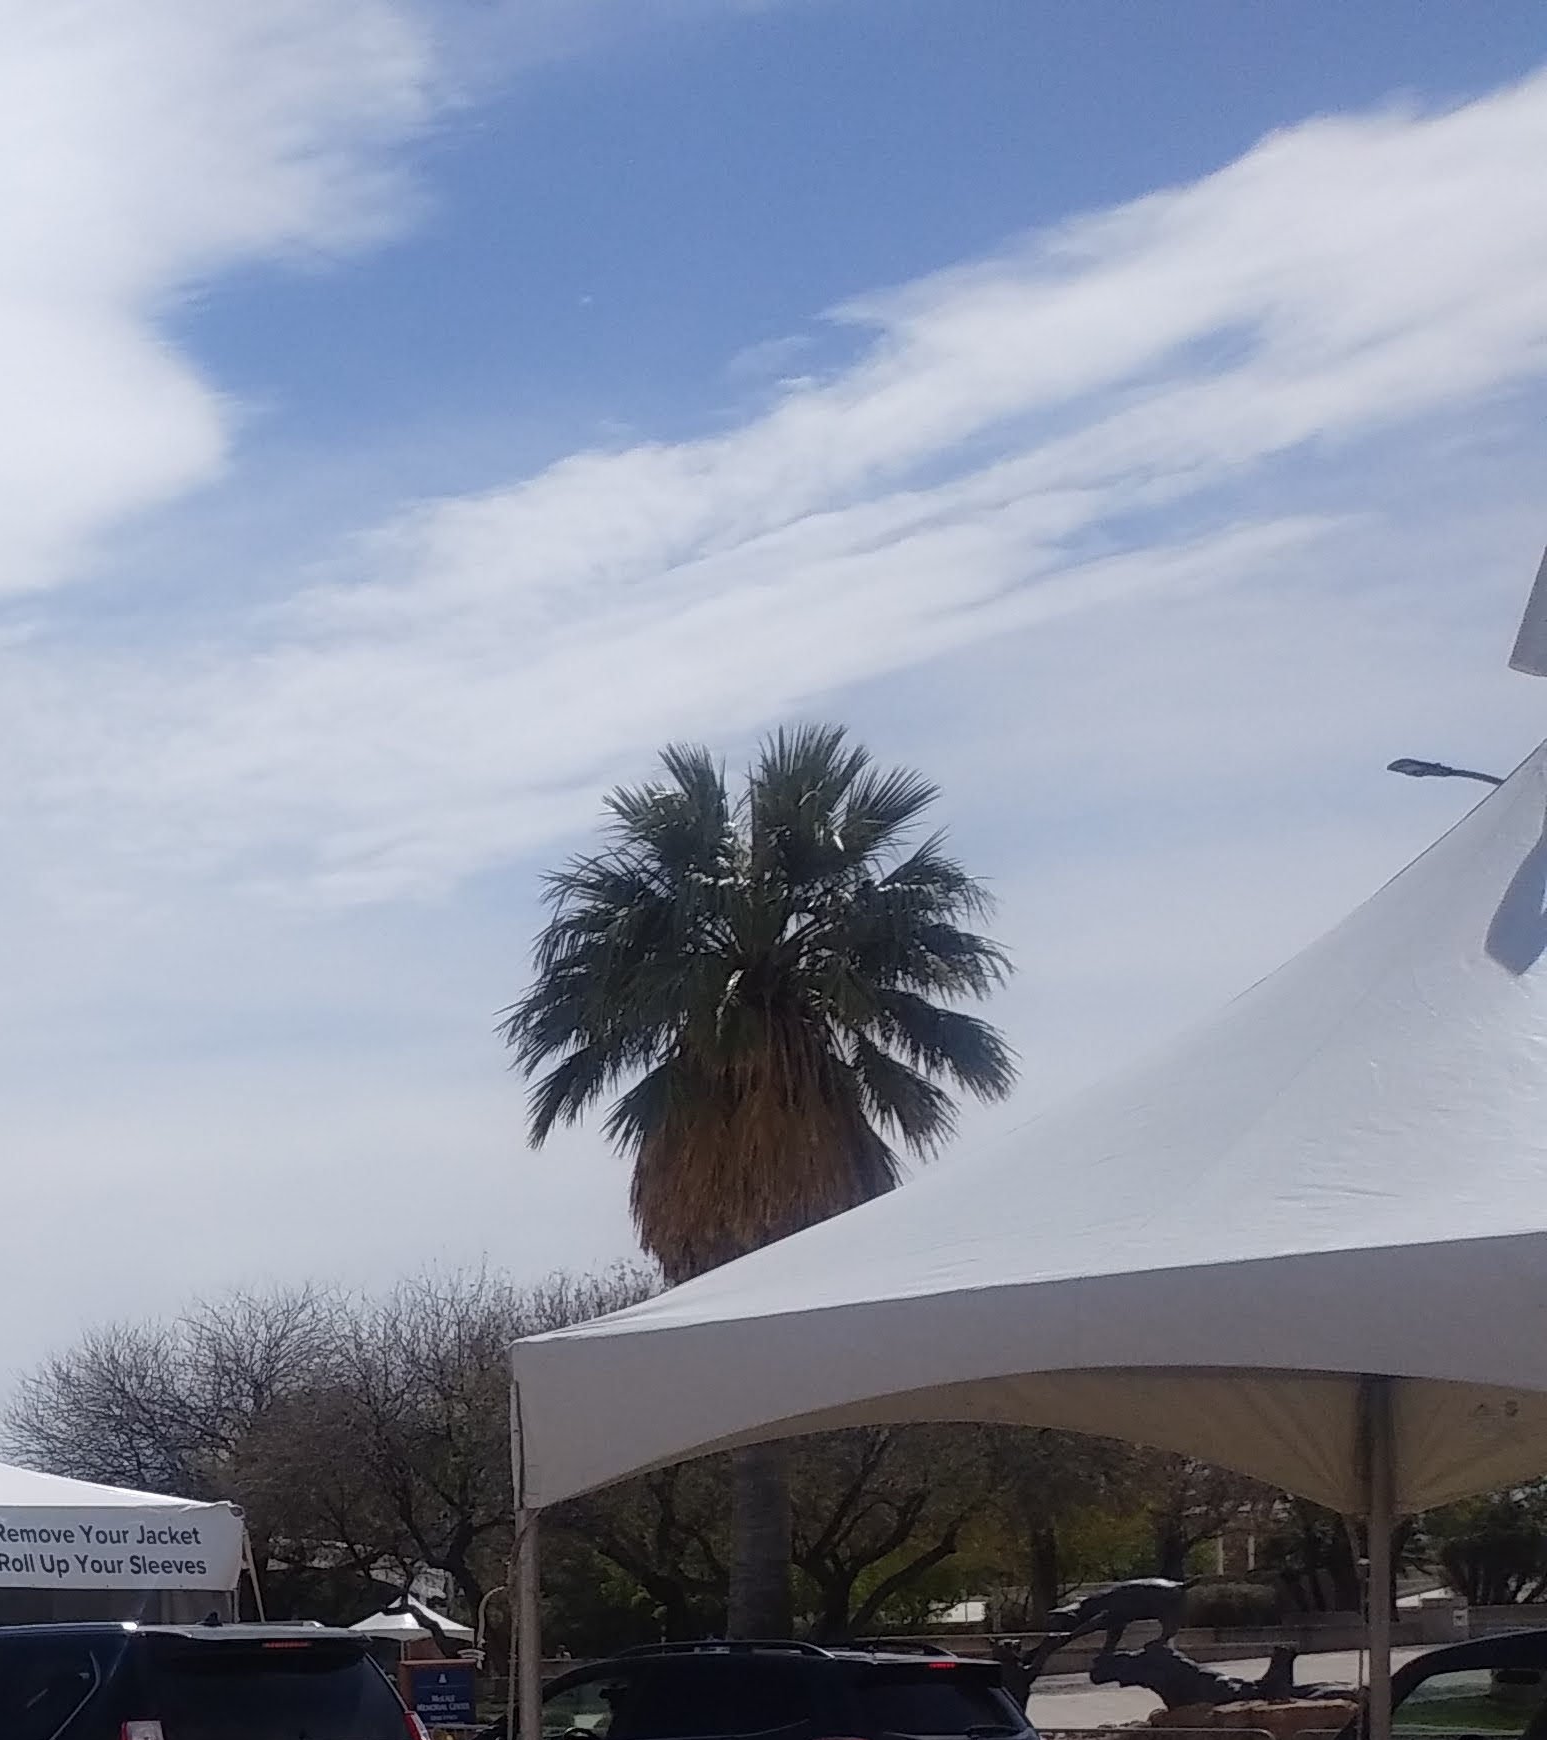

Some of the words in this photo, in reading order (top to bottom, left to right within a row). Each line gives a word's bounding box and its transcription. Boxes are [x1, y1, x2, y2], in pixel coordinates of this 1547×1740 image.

[79, 1525, 129, 1544] Your
[137, 1526, 201, 1544] Jacket
[40, 1554, 69, 1578] Up
[74, 1555, 123, 1573] Your
[130, 1555, 206, 1574] Sleeves
